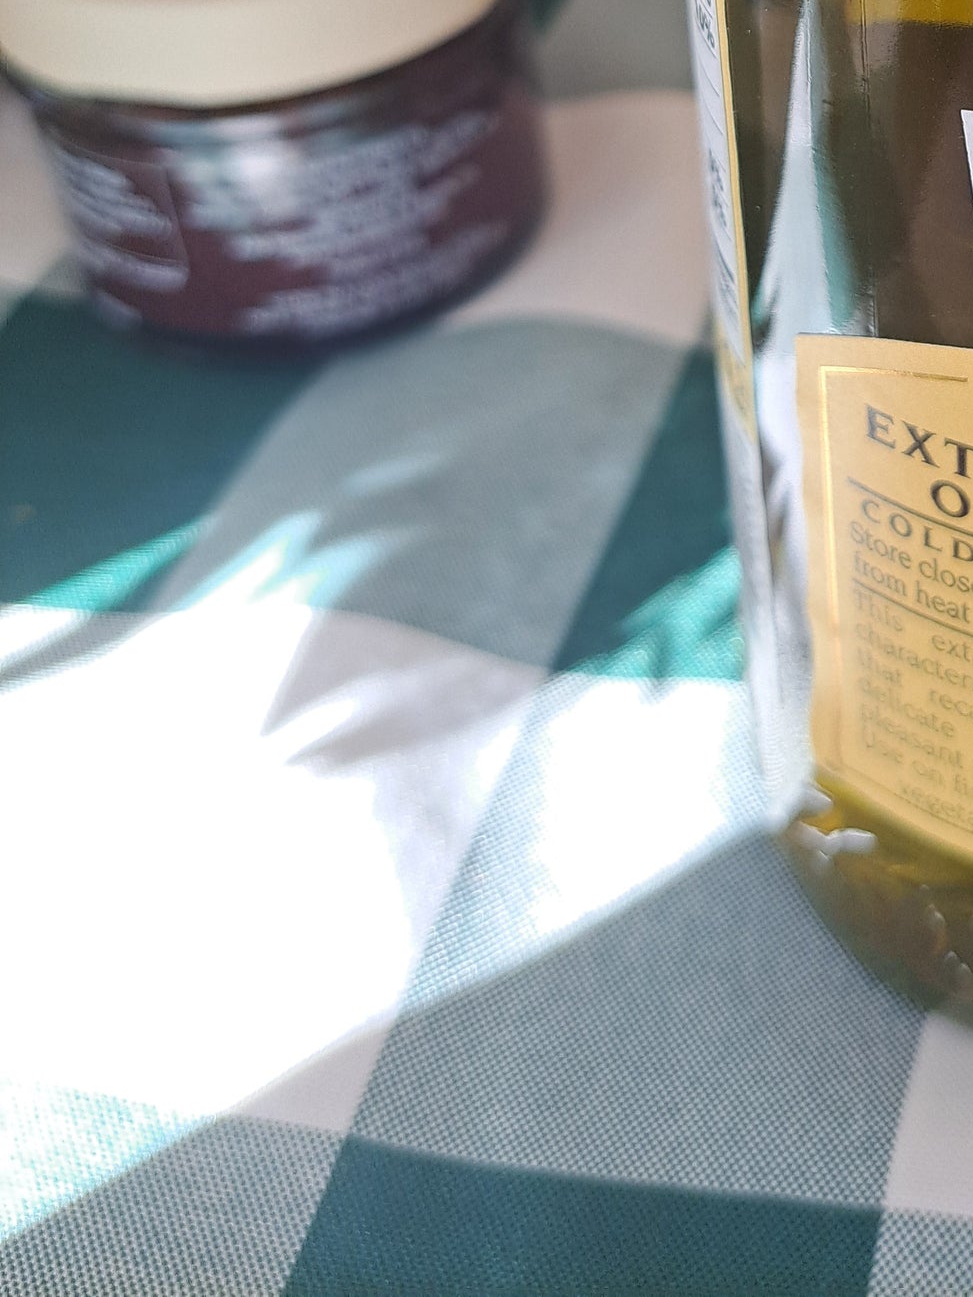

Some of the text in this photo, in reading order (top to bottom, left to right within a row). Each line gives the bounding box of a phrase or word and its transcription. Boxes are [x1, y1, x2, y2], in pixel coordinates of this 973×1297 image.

[850, 521, 912, 570] Store
[853, 551, 907, 596] from
[915, 580, 971, 624] heat
[855, 589, 904, 632] This
